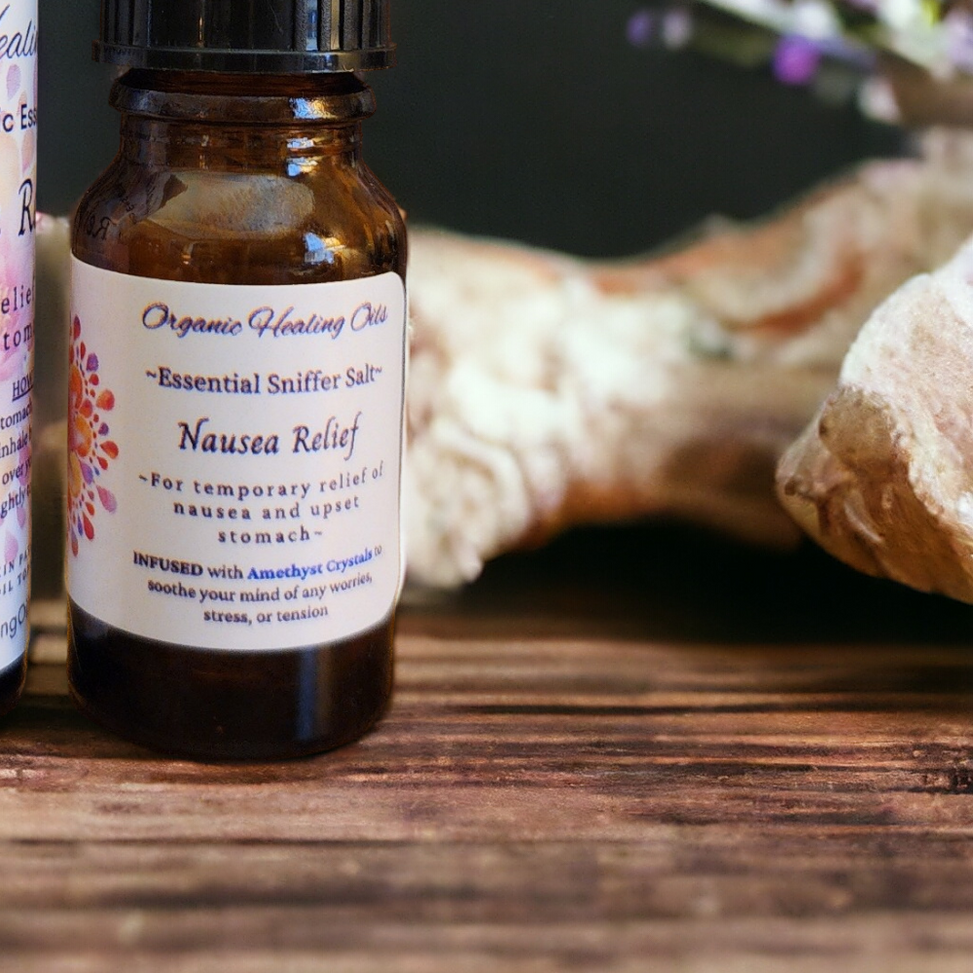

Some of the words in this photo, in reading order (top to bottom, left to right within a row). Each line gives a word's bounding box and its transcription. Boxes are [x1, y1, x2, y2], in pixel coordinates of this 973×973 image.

[142, 301, 243, 338] Organic
[247, 305, 345, 340] Healing
[350, 302, 388, 331] Oils
[145, 366, 260, 394] ~Essential
[267, 370, 342, 394] Sniffer
[345, 363, 382, 387] Salt~
[177, 417, 280, 454] Nausea
[292, 411, 362, 461] Relief
[138, 471, 183, 492] ~For
[193, 479, 311, 502] temporary
[319, 467, 367, 493] relief
[372, 460, 384, 479] of
[173, 500, 252, 520] nausea
[262, 502, 301, 519] and
[310, 495, 360, 520] upset
[217, 525, 323, 544] stomach~
[132, 550, 204, 577] INFUSED
[207, 565, 244, 580] with
[247, 563, 323, 582] Amethyst
[326, 547, 373, 574] Crystals
[147, 578, 197, 599] soothe
[199, 587, 236, 604] your
[239, 587, 280, 603] mind
[284, 585, 299, 600] of
[302, 583, 327, 601] any
[329, 571, 373, 594] worries,
[203, 608, 253, 625] stress,
[256, 612, 273, 623] or
[277, 605, 329, 623] tension
